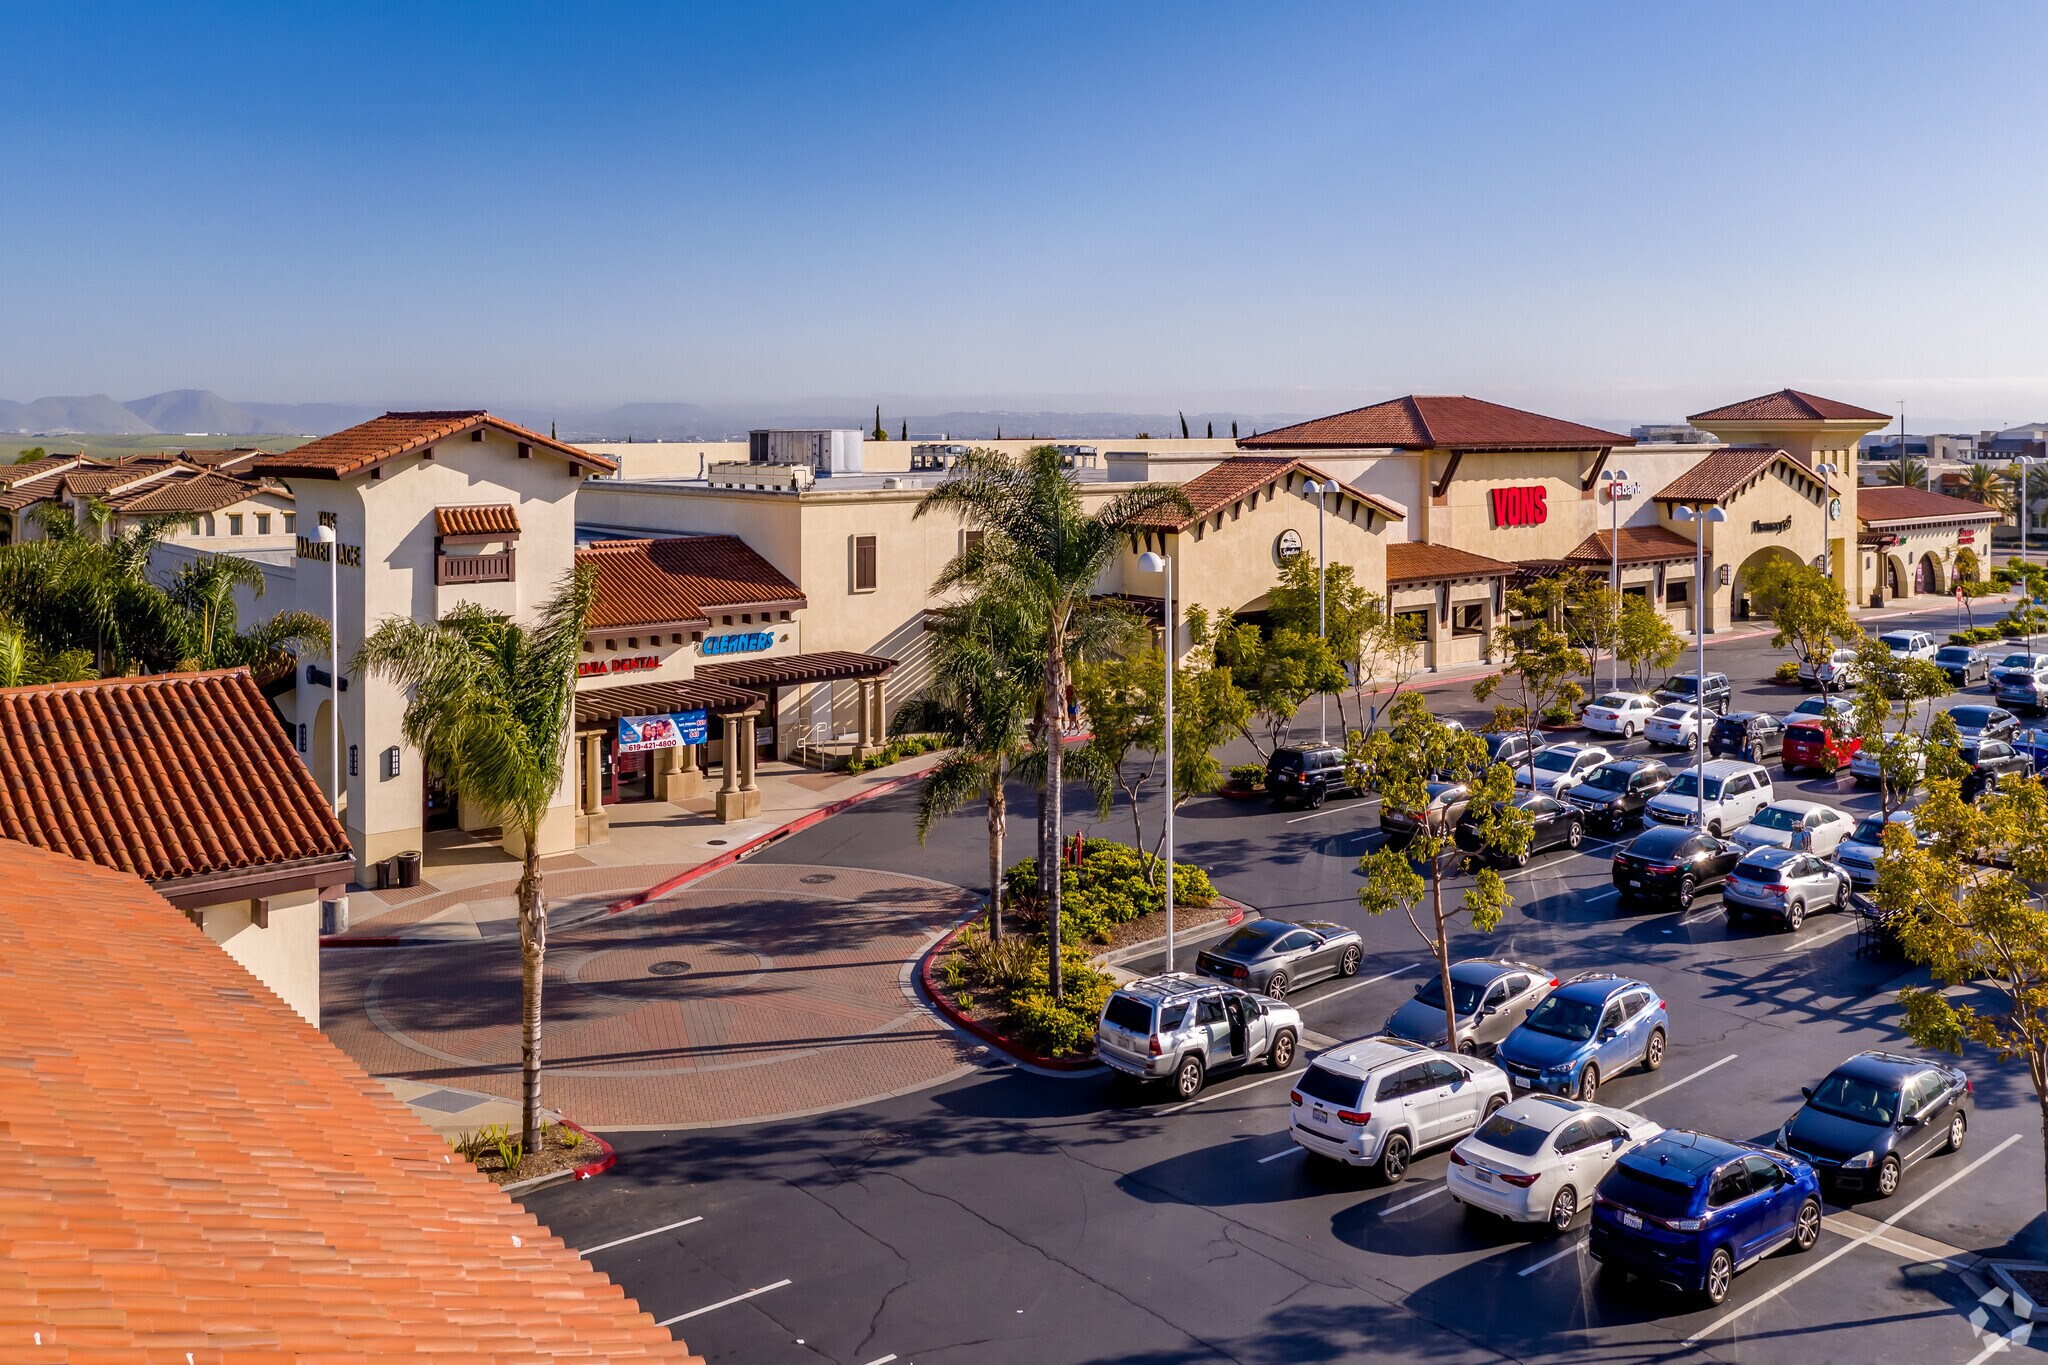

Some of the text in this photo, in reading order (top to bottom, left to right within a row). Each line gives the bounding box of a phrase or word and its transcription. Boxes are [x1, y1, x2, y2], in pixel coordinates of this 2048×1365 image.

[1491, 485, 1548, 527] VONS
[296, 535, 361, 568] MARKETLACE
[703, 632, 774, 655] CLEANERS
[578, 655, 663, 675] ENIA DENTAL
[628, 739, 677, 752] 619-421-4800
